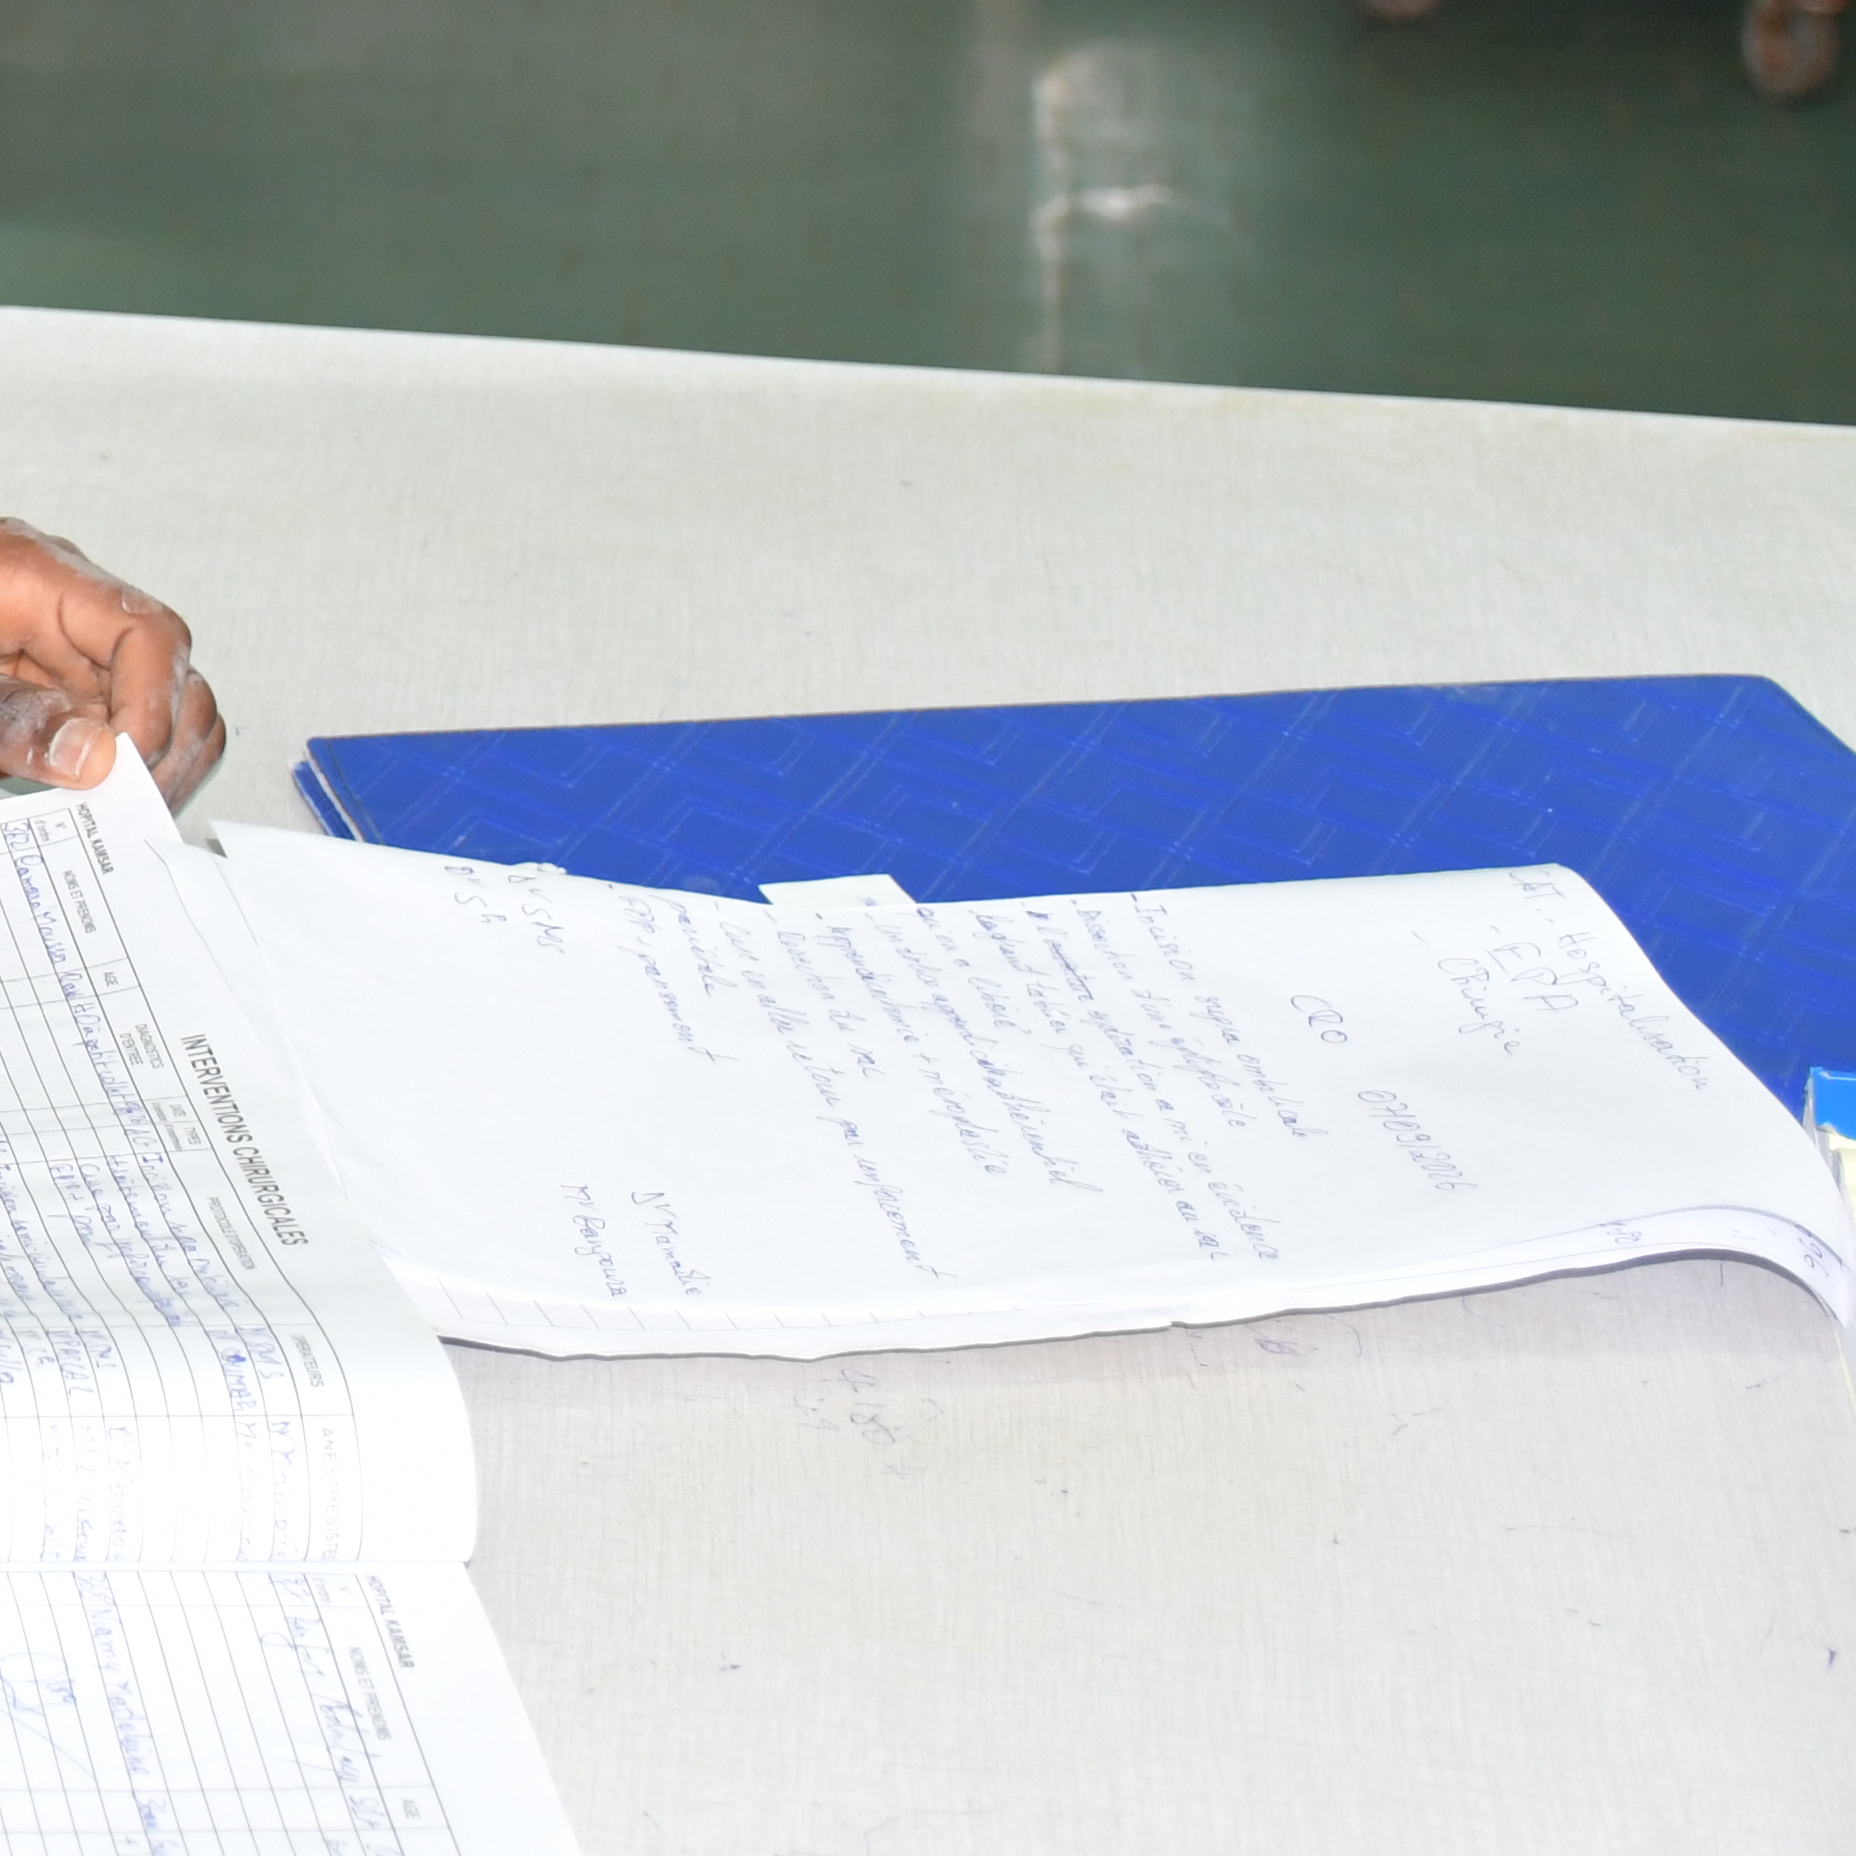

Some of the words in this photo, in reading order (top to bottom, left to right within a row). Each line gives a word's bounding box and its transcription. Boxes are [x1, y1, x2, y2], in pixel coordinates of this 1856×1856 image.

[74, 802, 98, 839] HOPITAL
[89, 837, 114, 874] KAMSAR
[100, 970, 119, 987] AGE
[1552, 932, 1711, 1089] Hospitalisation
[134, 1023, 164, 1069] DIAGNOSTICS
[179, 1033, 253, 1144] INTERVENTIONS
[233, 1146, 308, 1246] CHIRURGICALES
[365, 1571, 396, 1615] HOPITAL
[383, 1616, 415, 1670] KAMSAR
[400, 1797, 421, 1819] AGE
